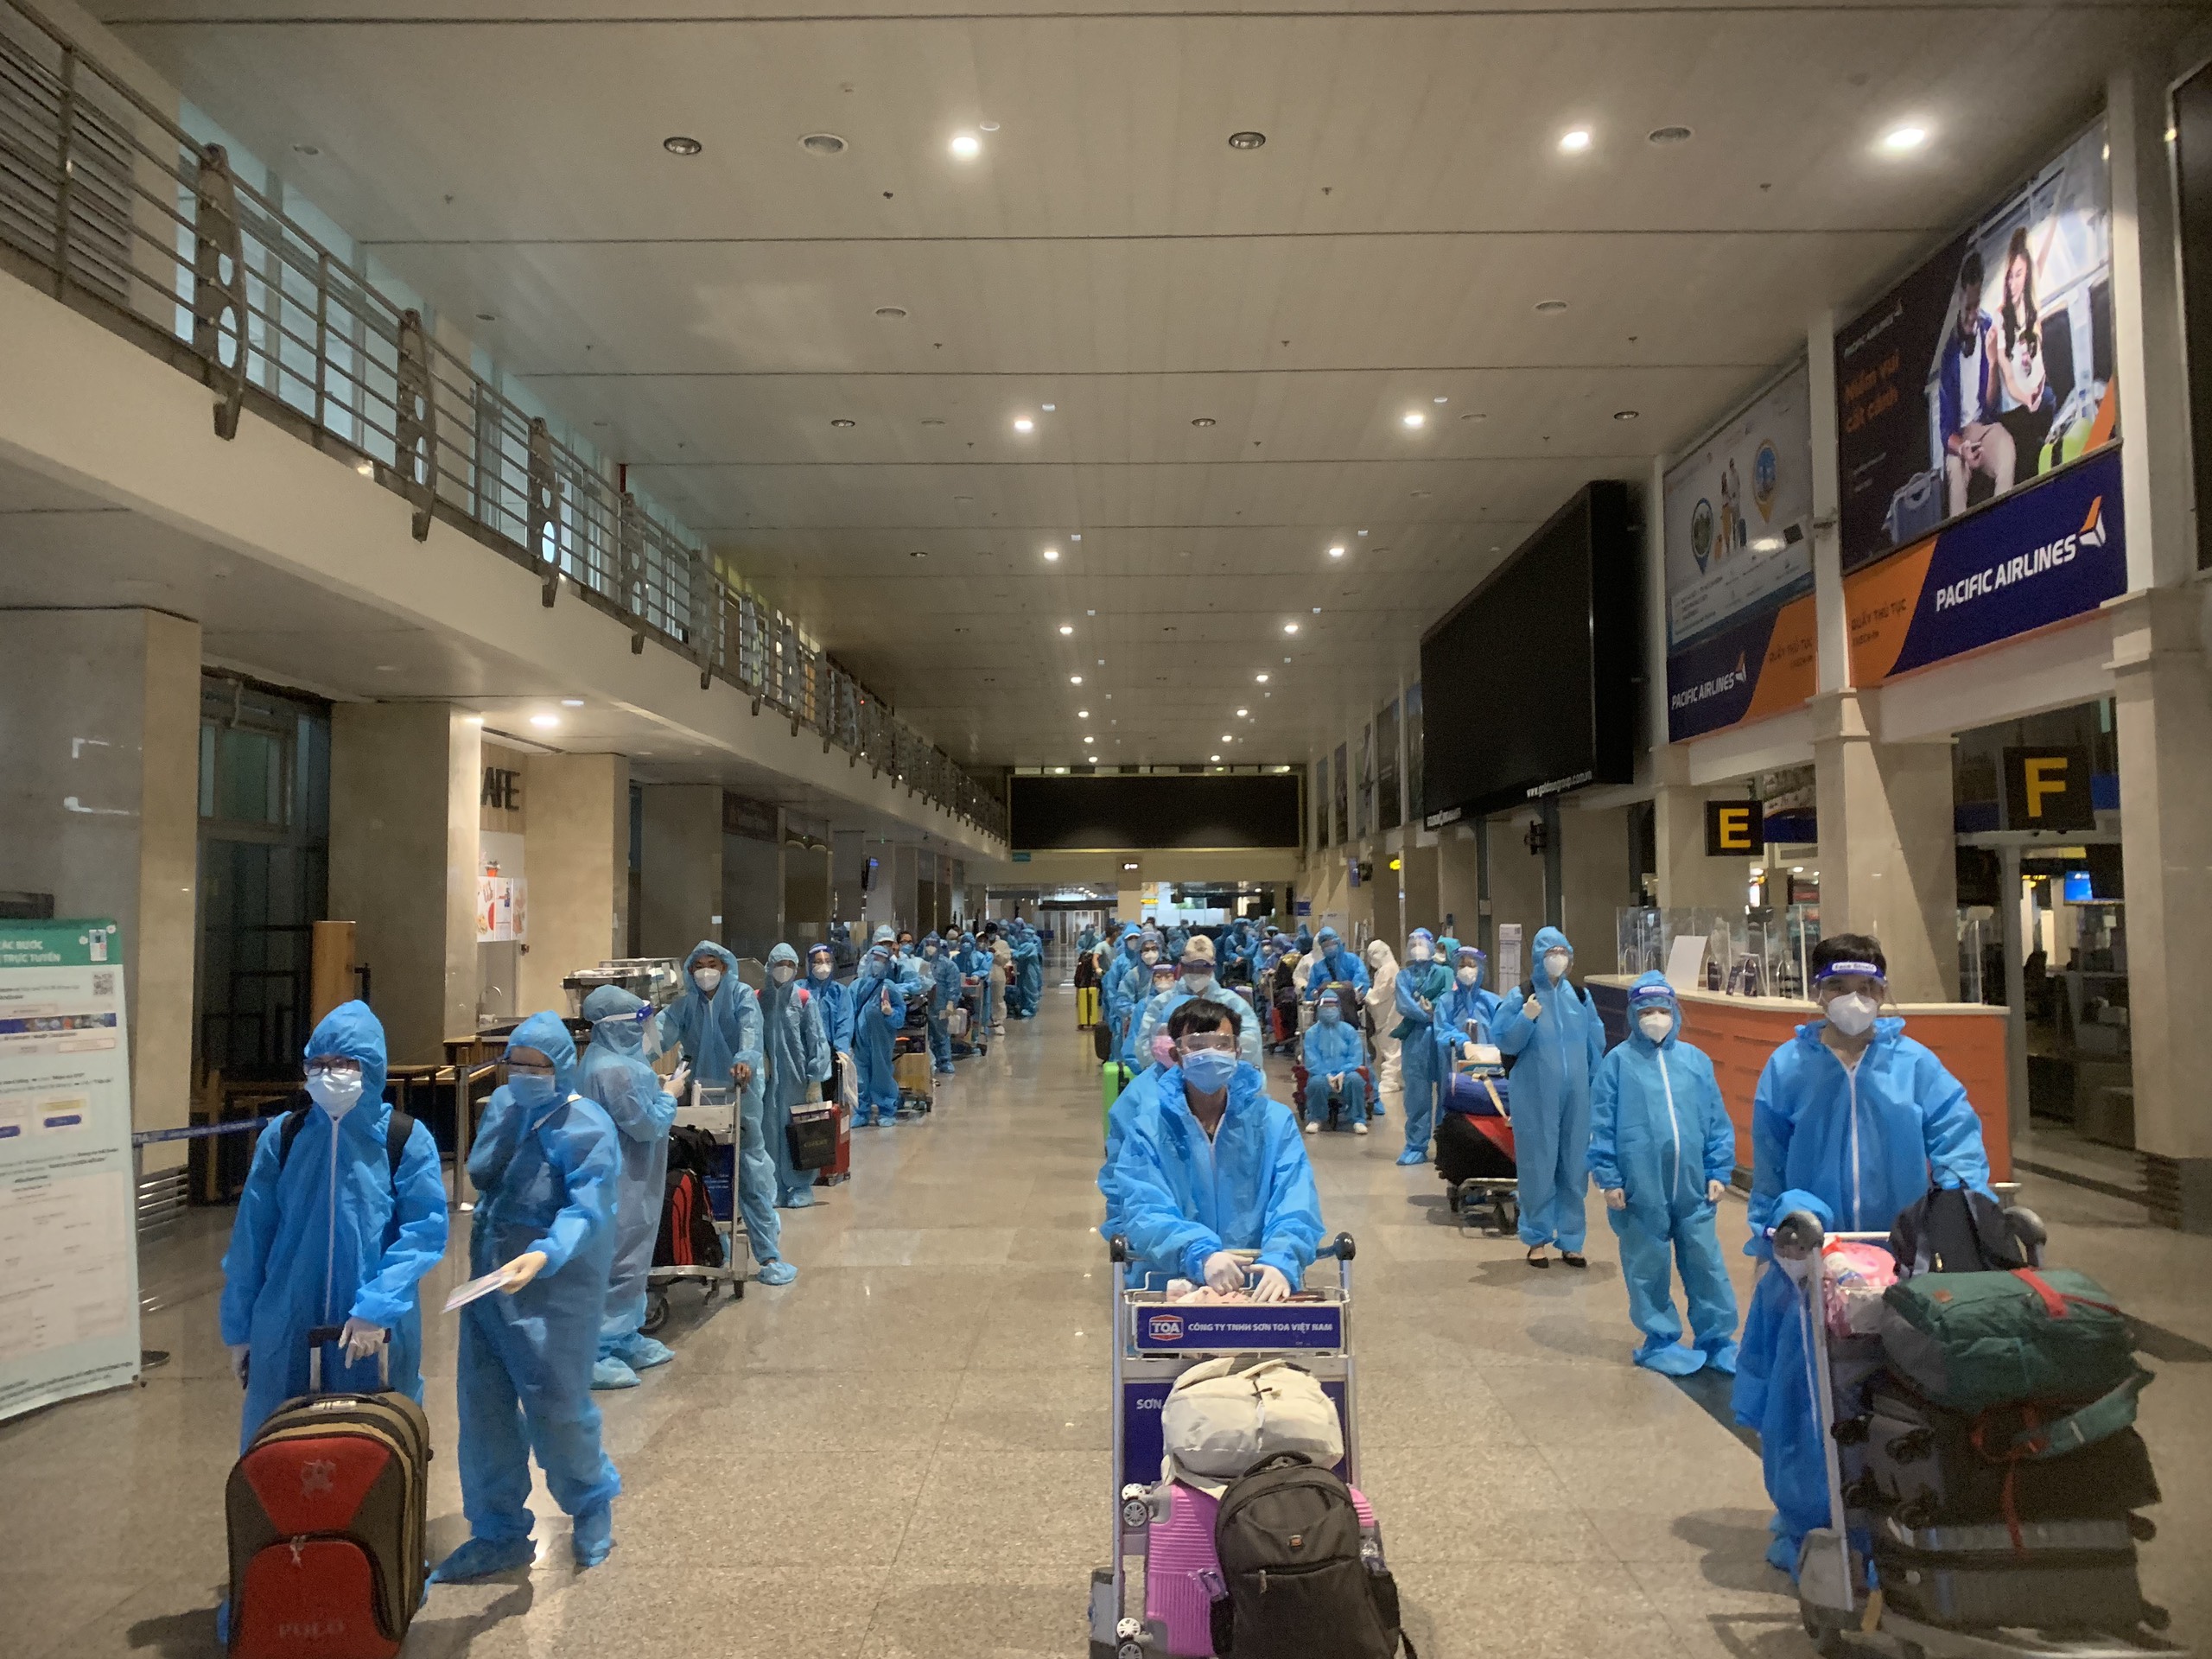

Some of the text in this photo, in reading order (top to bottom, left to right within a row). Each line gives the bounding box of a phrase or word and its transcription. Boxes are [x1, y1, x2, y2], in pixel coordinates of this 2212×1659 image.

[1936, 533, 2077, 612] PACIFIC AIRLINES
[1671, 671, 1735, 710] PACIFIC AIRLINES
[480, 766, 520, 810] AFE
[2024, 757, 2068, 817] F
[1719, 808, 1751, 849] E
[1152, 1322, 1180, 1333] TOA
[1188, 1322, 1333, 1334] CÔNG TY TNHH SƠN TOA VIỆT NAM
[1136, 1397, 1162, 1409] SƠN
